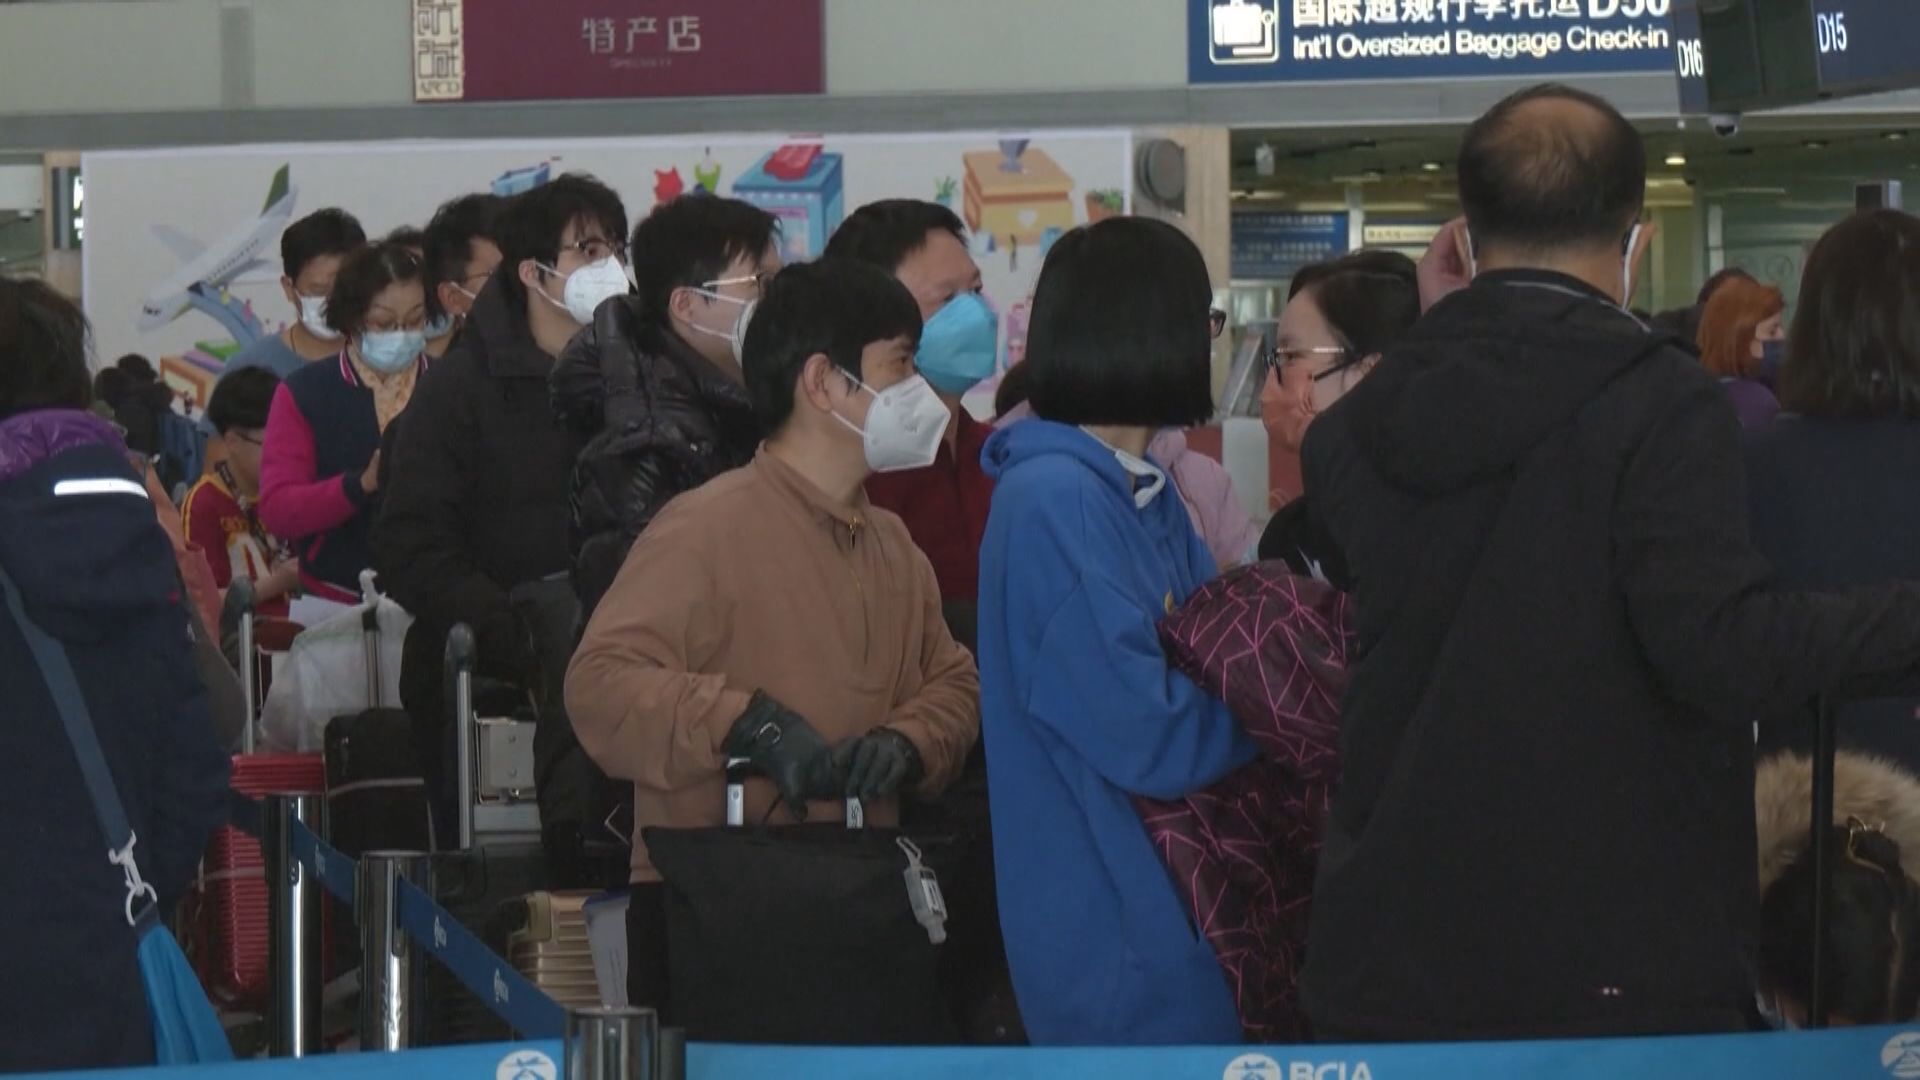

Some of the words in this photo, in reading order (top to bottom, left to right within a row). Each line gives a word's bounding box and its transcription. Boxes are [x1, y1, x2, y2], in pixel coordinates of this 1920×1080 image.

[1292, 0, 1581, 28] 国际超规行李托运
[1817, 12, 1847, 53] D15
[582, 16, 700, 53] 特产店
[1293, 34, 1332, 59] Int'l
[1336, 31, 1450, 58] Oversized
[1455, 29, 1561, 59] Baggage
[1566, 24, 1668, 50] Check-in
[1677, 39, 1704, 77] D16
